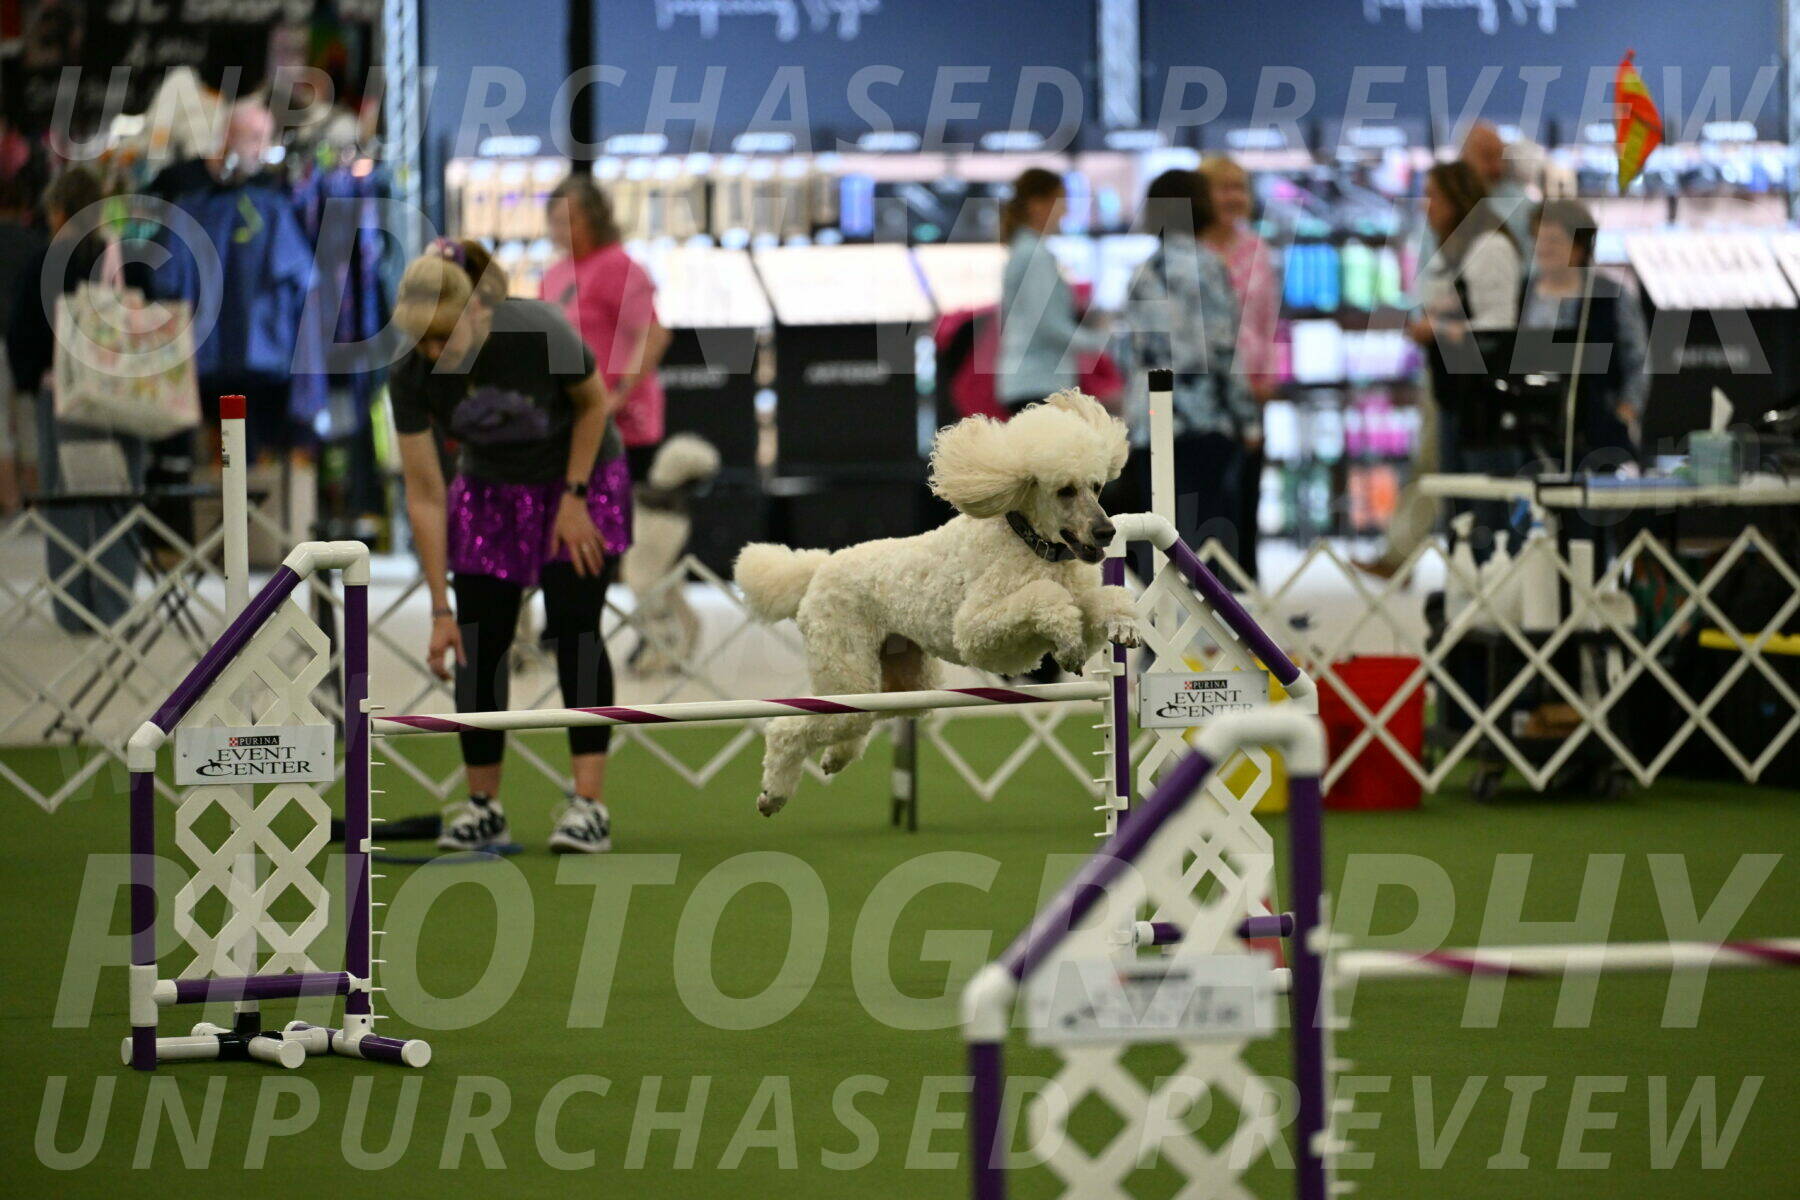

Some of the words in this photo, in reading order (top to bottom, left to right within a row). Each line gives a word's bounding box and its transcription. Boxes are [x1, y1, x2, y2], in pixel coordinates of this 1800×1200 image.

[1192, 680, 1228, 690] PURINA
[1174, 690, 1242, 704] EVENT
[239, 736, 279, 746] PURINA
[217, 746, 296, 762] EVENT
[195, 760, 312, 777] CENTER
